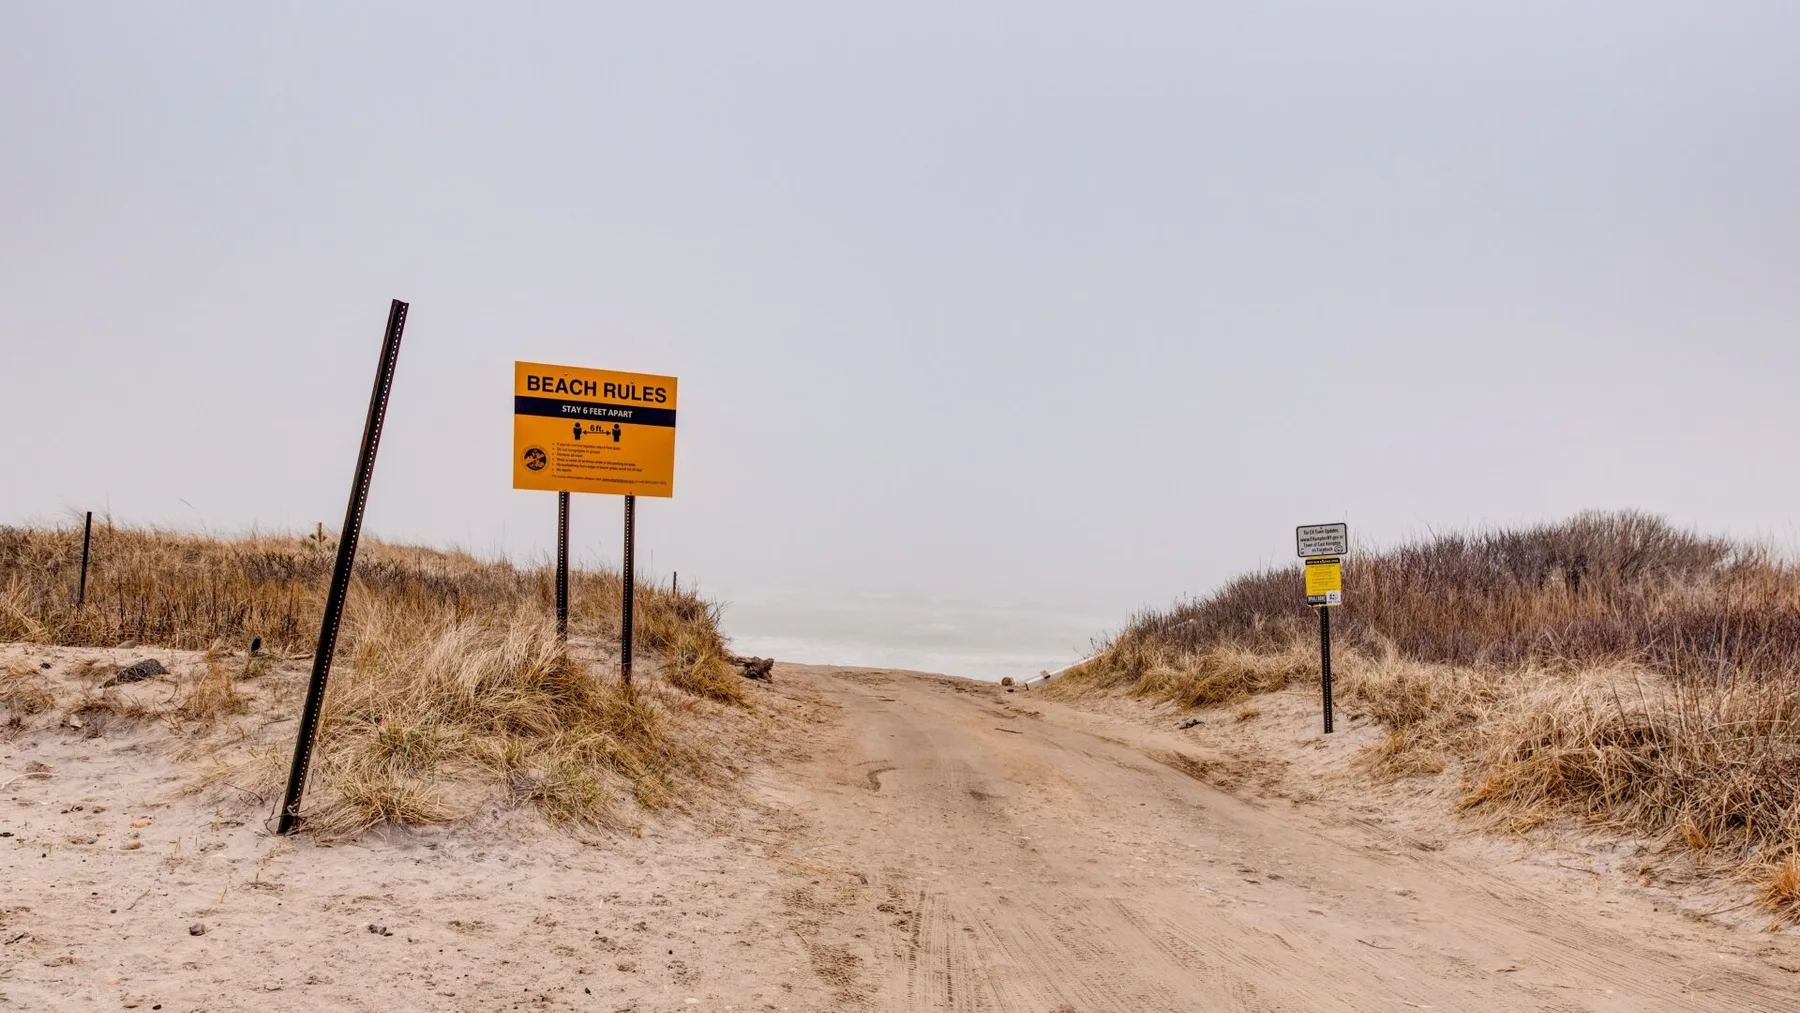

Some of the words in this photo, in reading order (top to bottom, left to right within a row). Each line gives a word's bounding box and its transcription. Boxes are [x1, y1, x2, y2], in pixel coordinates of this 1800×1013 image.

[527, 375, 597, 397] BEACH
[603, 382, 667, 403] RULES
[562, 405, 581, 413] STAY
[589, 407, 607, 416] FEET
[608, 409, 633, 418] APART
